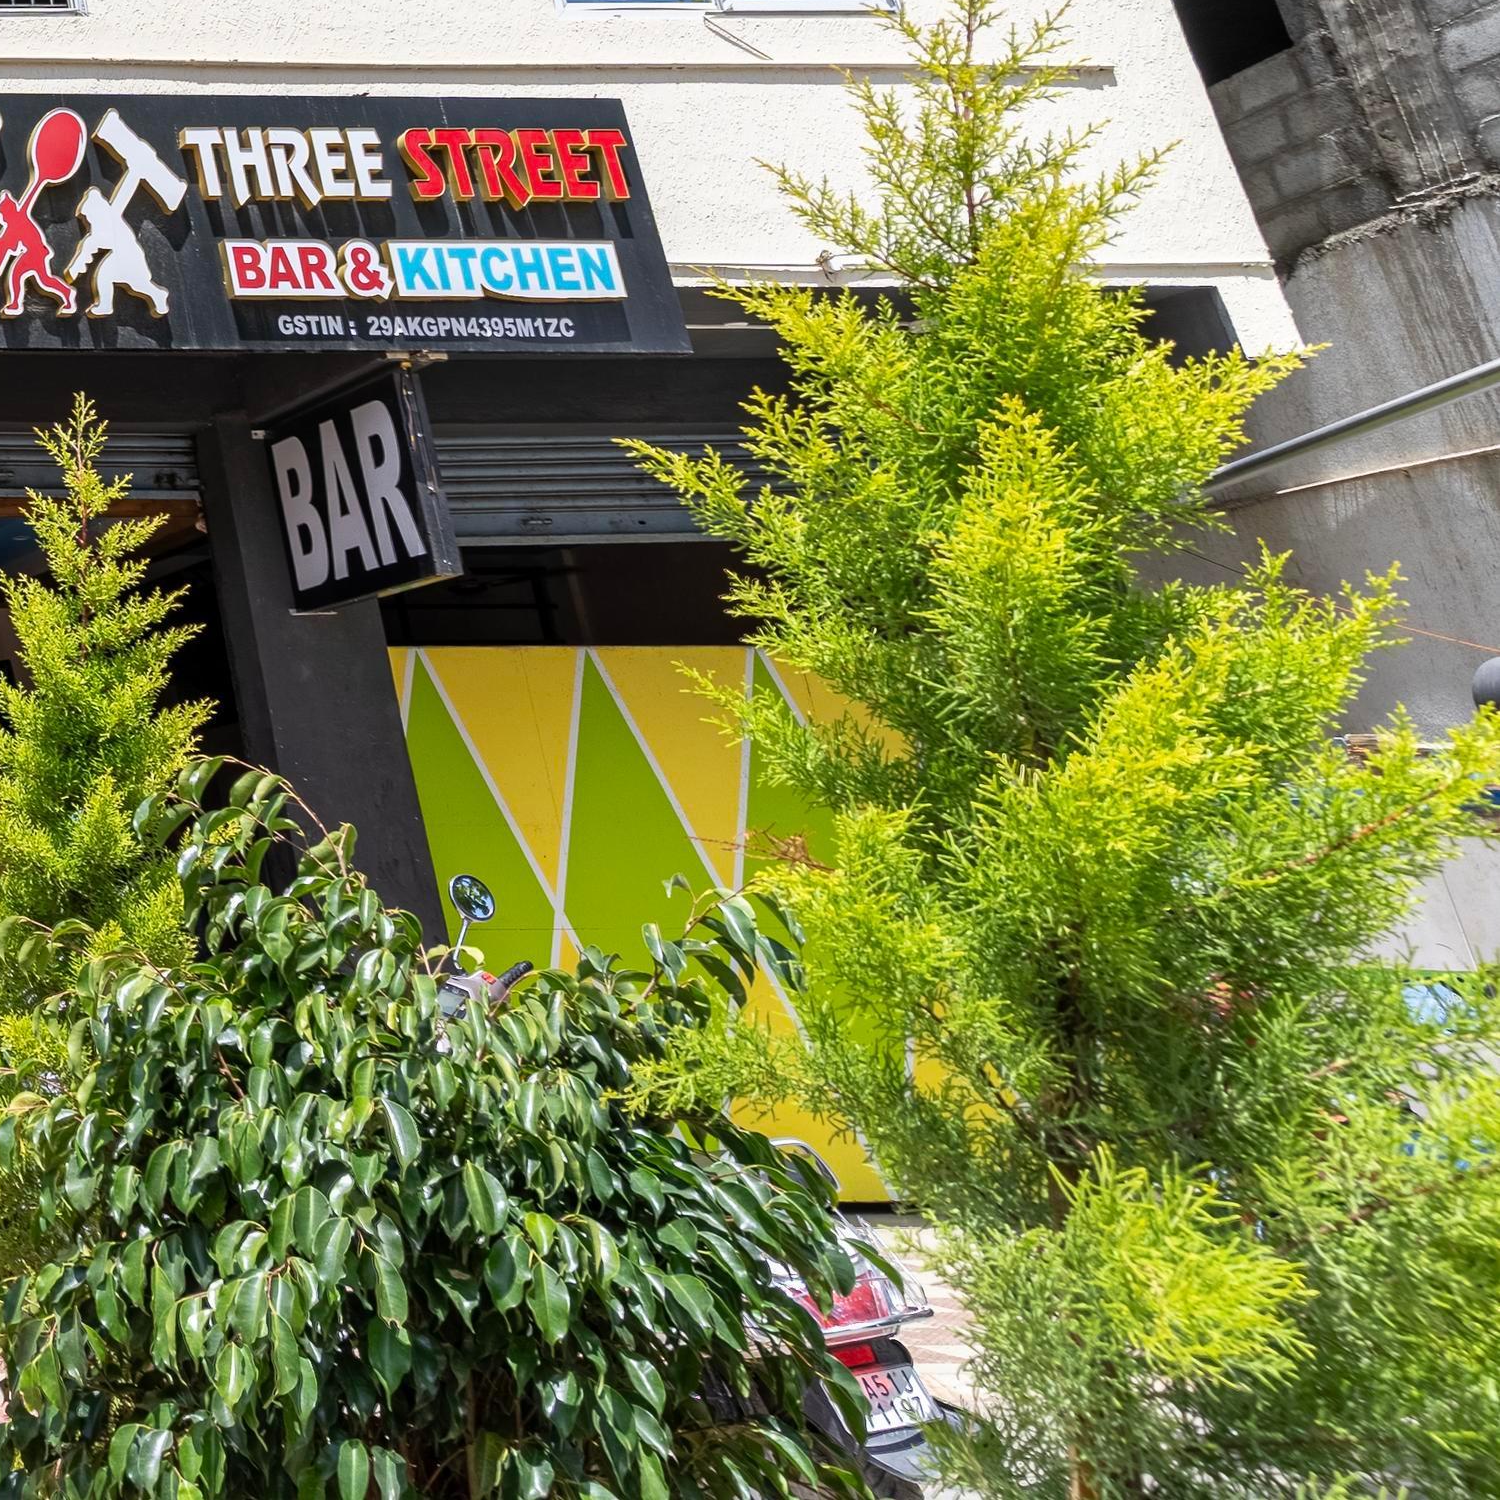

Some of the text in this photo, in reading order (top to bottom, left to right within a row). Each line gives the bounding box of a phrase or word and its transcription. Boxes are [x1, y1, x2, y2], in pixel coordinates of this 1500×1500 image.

[179, 126, 630, 211] THREE STREET
[232, 246, 337, 290] BAR
[397, 247, 616, 291] KITCHEN
[278, 315, 344, 336] GSTIN
[367, 316, 575, 338] 29AKGPN4395M1ZC
[271, 400, 427, 591] BAR
